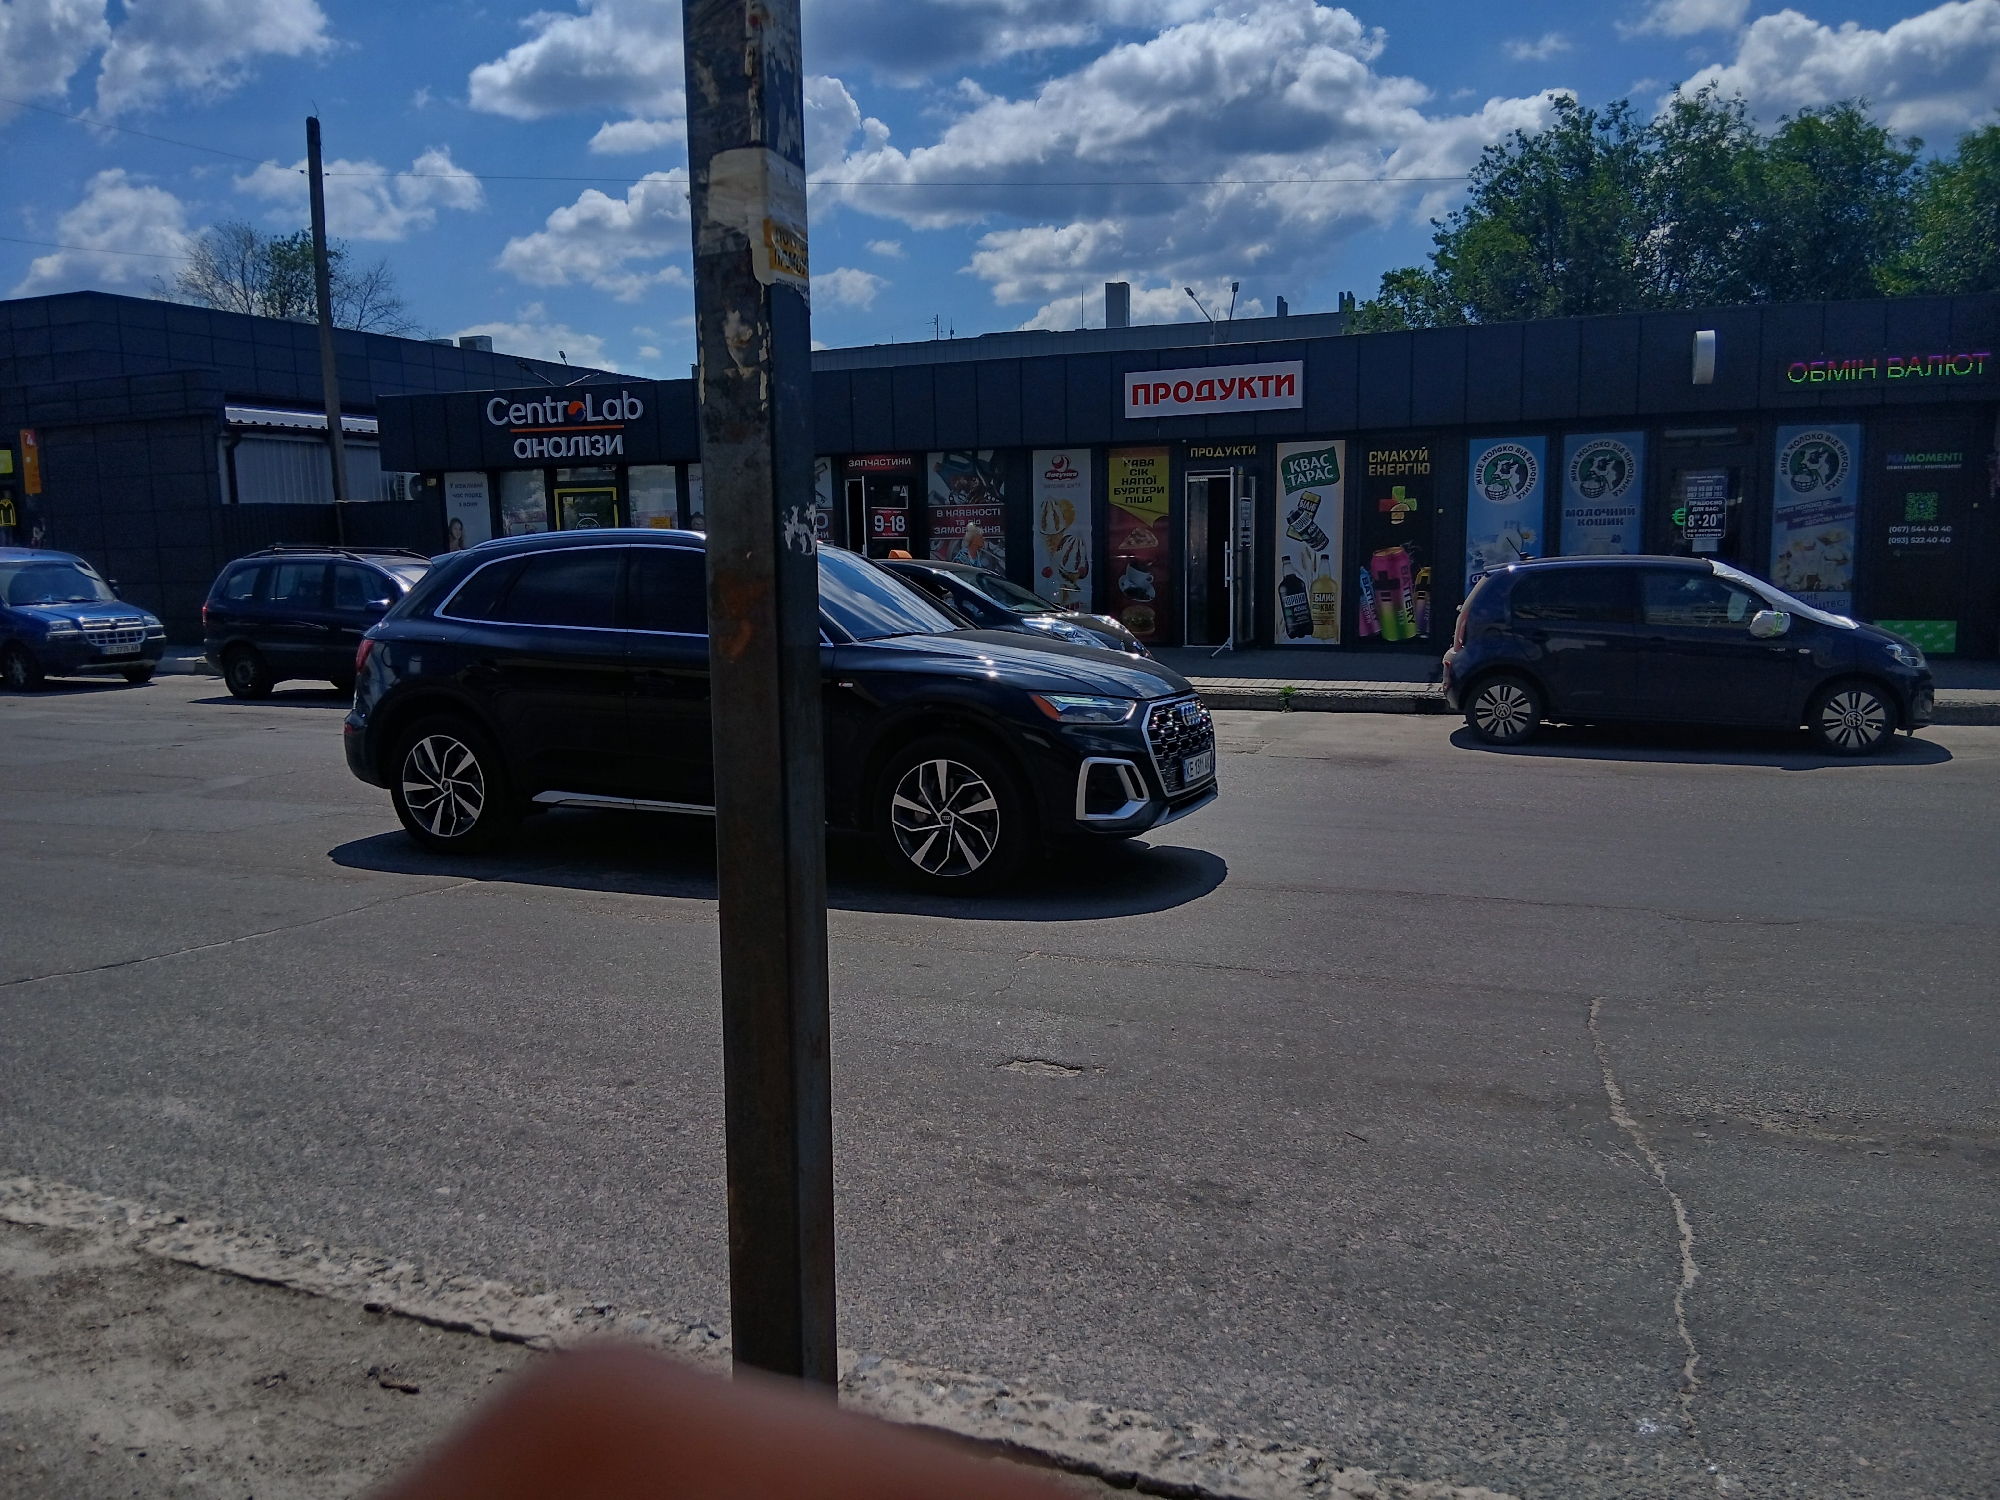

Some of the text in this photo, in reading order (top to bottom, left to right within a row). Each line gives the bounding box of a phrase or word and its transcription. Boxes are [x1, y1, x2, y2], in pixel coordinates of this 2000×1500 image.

[1787, 352, 1991, 383] ОБМІН ВАЛЮТ
[1132, 373, 1295, 406] ПРОДУКТИ
[486, 390, 644, 426] CentroLab
[513, 434, 624, 459] аналізи
[1190, 445, 1256, 458] ПРОДУКТИ
[848, 457, 912, 468] ЗАПЧАСТИНИ
[1368, 447, 1428, 464] СМАКУЙ
[1780, 433, 1849, 492] ЖИВЕ МОЛОКО ВІД ВИРОБНИКА
[1123, 458, 1154, 468] КАВА
[1288, 454, 1330, 474] КВАС
[1368, 462, 1431, 477] ЕНЕРГІЮ
[1570, 441, 1634, 497] ЖИВЕ МОЛОКО ВІД ВИРОБНИКА
[1286, 465, 1334, 487] ТАРАС
[1475, 445, 1537, 500] ЖИВЕ МОЛОКО ВІД ВИРОБНИКА
[1122, 475, 1157, 486] НАПОЇ
[1113, 486, 1165, 496] БУРГЕРИ
[936, 508, 1001, 518] В НАЯВНОСТІ
[1565, 504, 1636, 518] МОЛОЧНИЙ
[1795, 501, 1822, 511] МОЛОКО
[874, 515, 906, 532] 9-18
[1577, 518, 1624, 527] КОШИК
[1804, 516, 1833, 526] ЗДОРОВА
[934, 525, 1001, 535] ЗАМОВННЯ
[1910, 536, 1926, 544] 522
[1400, 565, 1415, 624] BATTERY
[1320, 604, 1335, 612] КВАС
